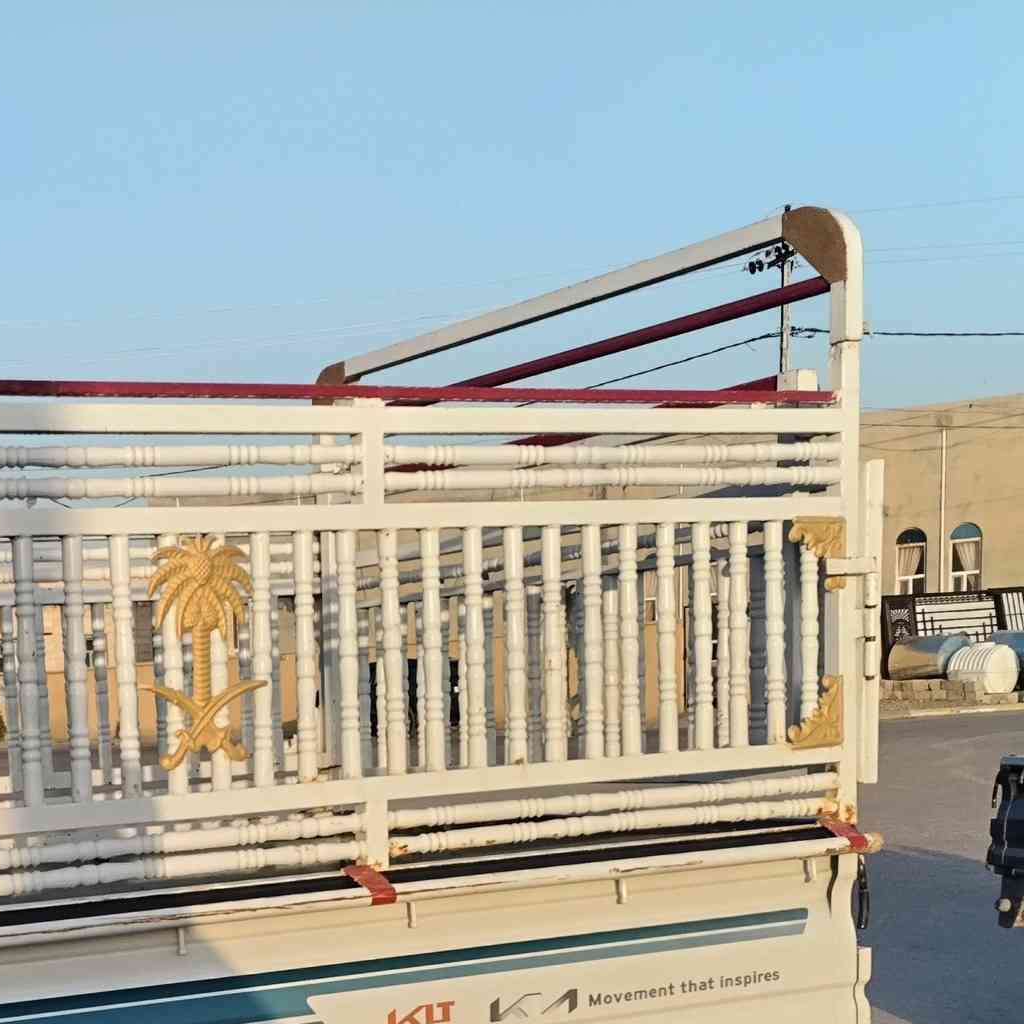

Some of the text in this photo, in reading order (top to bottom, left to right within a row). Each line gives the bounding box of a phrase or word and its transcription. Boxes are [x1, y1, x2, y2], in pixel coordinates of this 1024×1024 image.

[588, 983, 675, 1007] Movement
[680, 977, 715, 994] that
[719, 969, 781, 988] inspires
